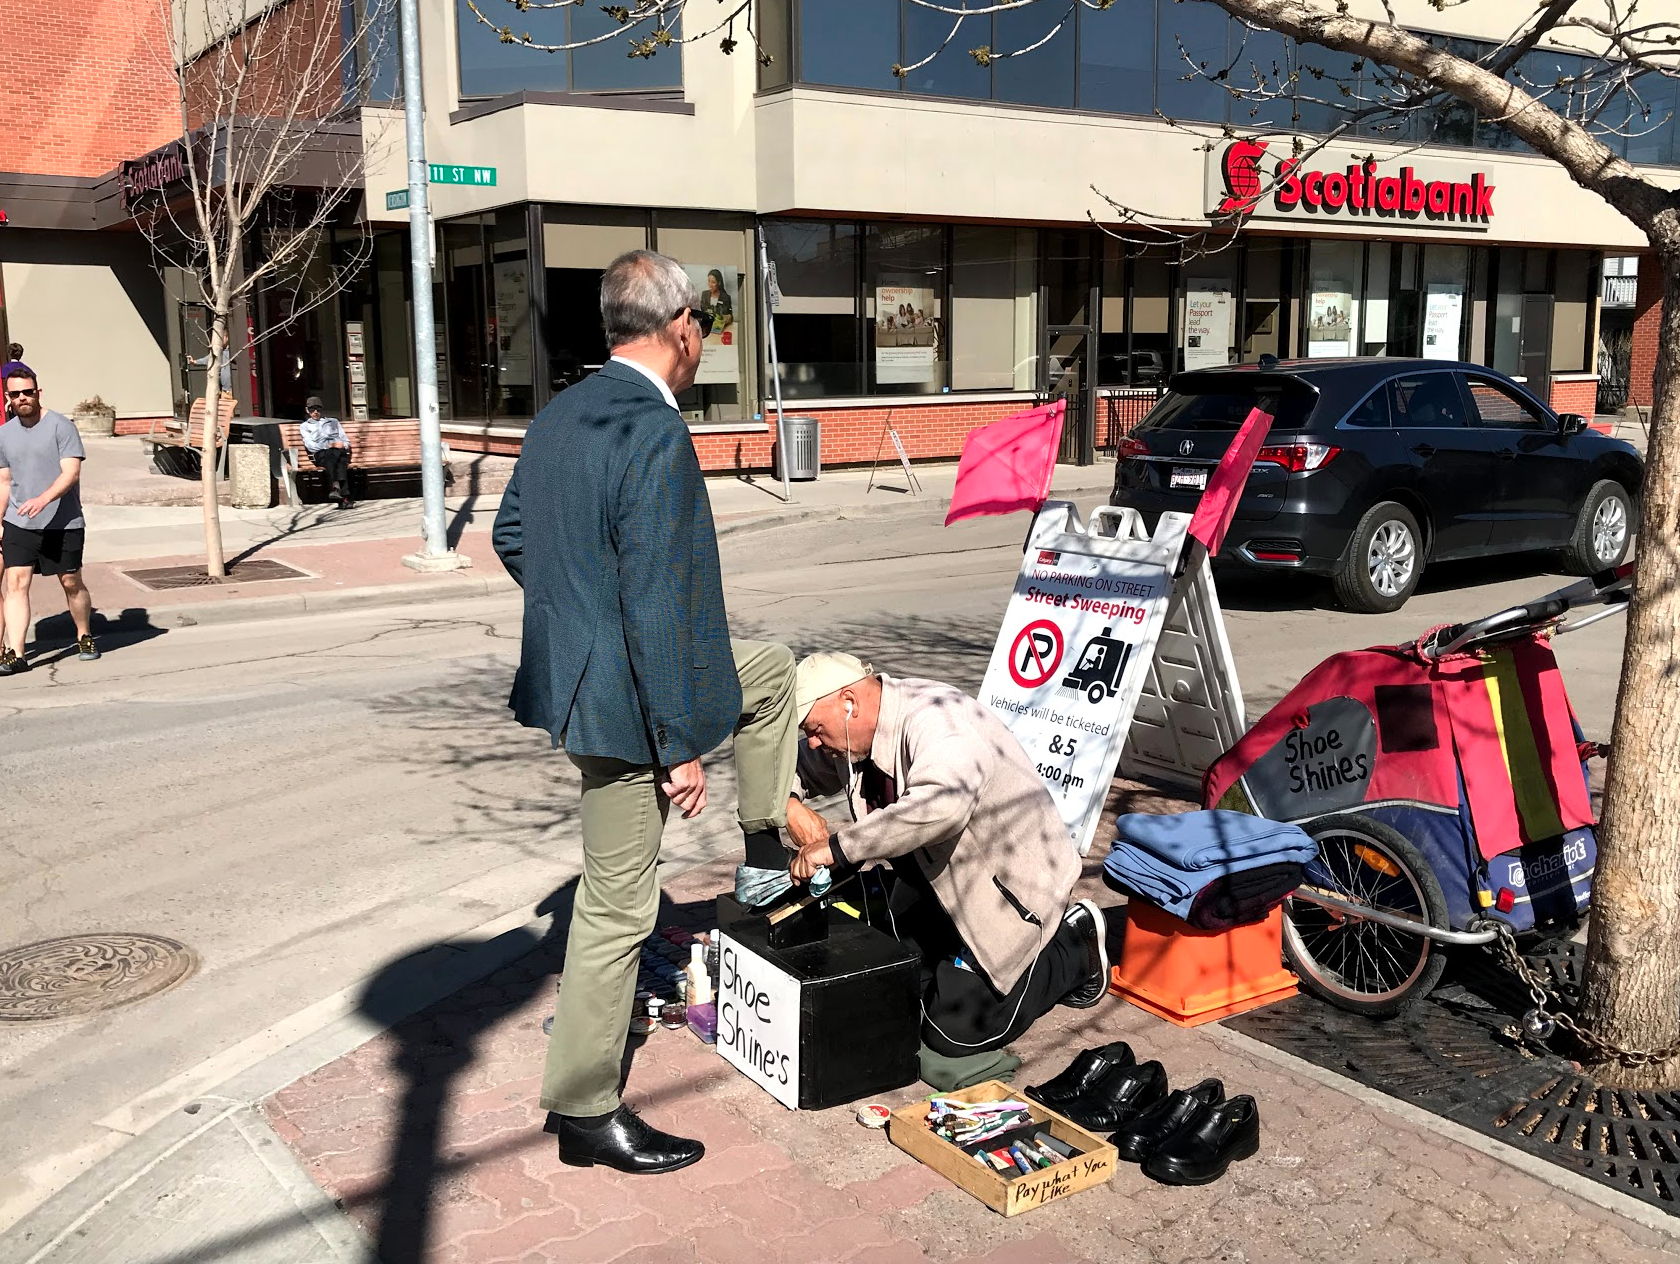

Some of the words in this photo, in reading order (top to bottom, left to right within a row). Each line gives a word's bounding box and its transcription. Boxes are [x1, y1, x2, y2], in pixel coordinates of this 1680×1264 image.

[128, 145, 185, 197] Scotiabank
[433, 166, 444, 181] 11
[452, 167, 465, 182] ST
[474, 169, 491, 184] NW
[1276, 156, 1496, 217] Scotiabank
[881, 294, 895, 303] help
[1189, 300, 1199, 308] Let
[1199, 301, 1212, 309] your
[1189, 309, 1213, 318] Passport
[1188, 318, 1201, 326] lead
[1188, 326, 1198, 334] the
[1428, 311, 1448, 319] Passport
[1031, 568, 1048, 581] NO
[1049, 571, 1093, 589] PARKING
[1095, 578, 1113, 592] ON
[1113, 581, 1155, 597] STREET
[1025, 586, 1069, 608] Street
[1070, 593, 1146, 625] Sweeping
[990, 694, 1029, 716] Vehicles
[1031, 707, 1050, 721] will
[1050, 709, 1064, 725] be
[1065, 714, 1111, 737] ticketed
[1284, 729, 1343, 763] Shoe
[1061, 773, 1084, 789] pm
[1529, 840, 1587, 878] chariot
[723, 947, 771, 1024] Shoe
[721, 1002, 790, 1085] Shine's
[1015, 1182, 1040, 1203] Pay
[1083, 1158, 1108, 1178] You
